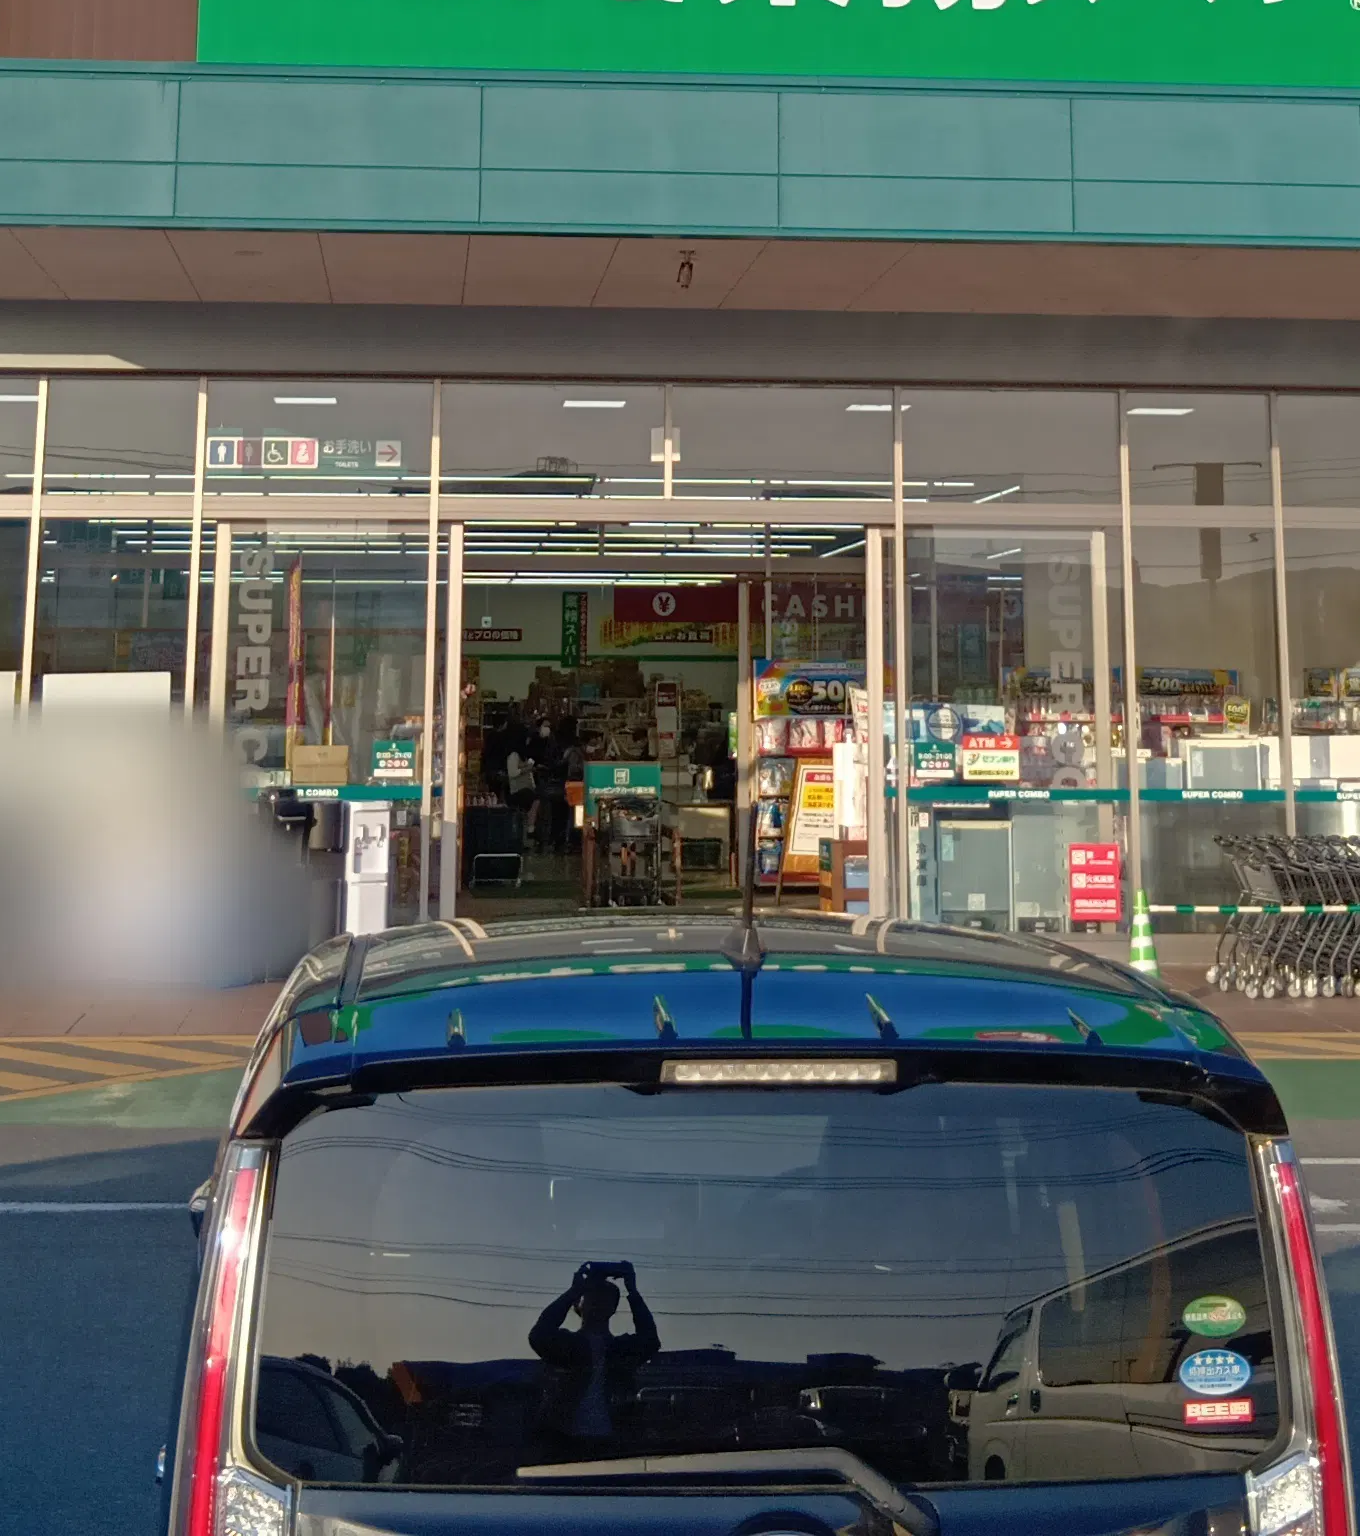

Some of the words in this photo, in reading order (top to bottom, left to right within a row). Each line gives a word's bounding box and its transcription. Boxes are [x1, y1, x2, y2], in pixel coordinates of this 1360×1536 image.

[323, 439, 372, 454] お手洗い
[761, 595, 866, 618] CASH
[234, 547, 275, 715] SUPER
[1048, 556, 1086, 712] SUPER
[968, 737, 996, 749] ATM
[306, 789, 338, 797] COMBO
[988, 790, 1017, 798] SUPER
[1018, 790, 1050, 799] COMBO
[1182, 790, 1210, 799] SUPER
[1211, 790, 1243, 799] COMBO
